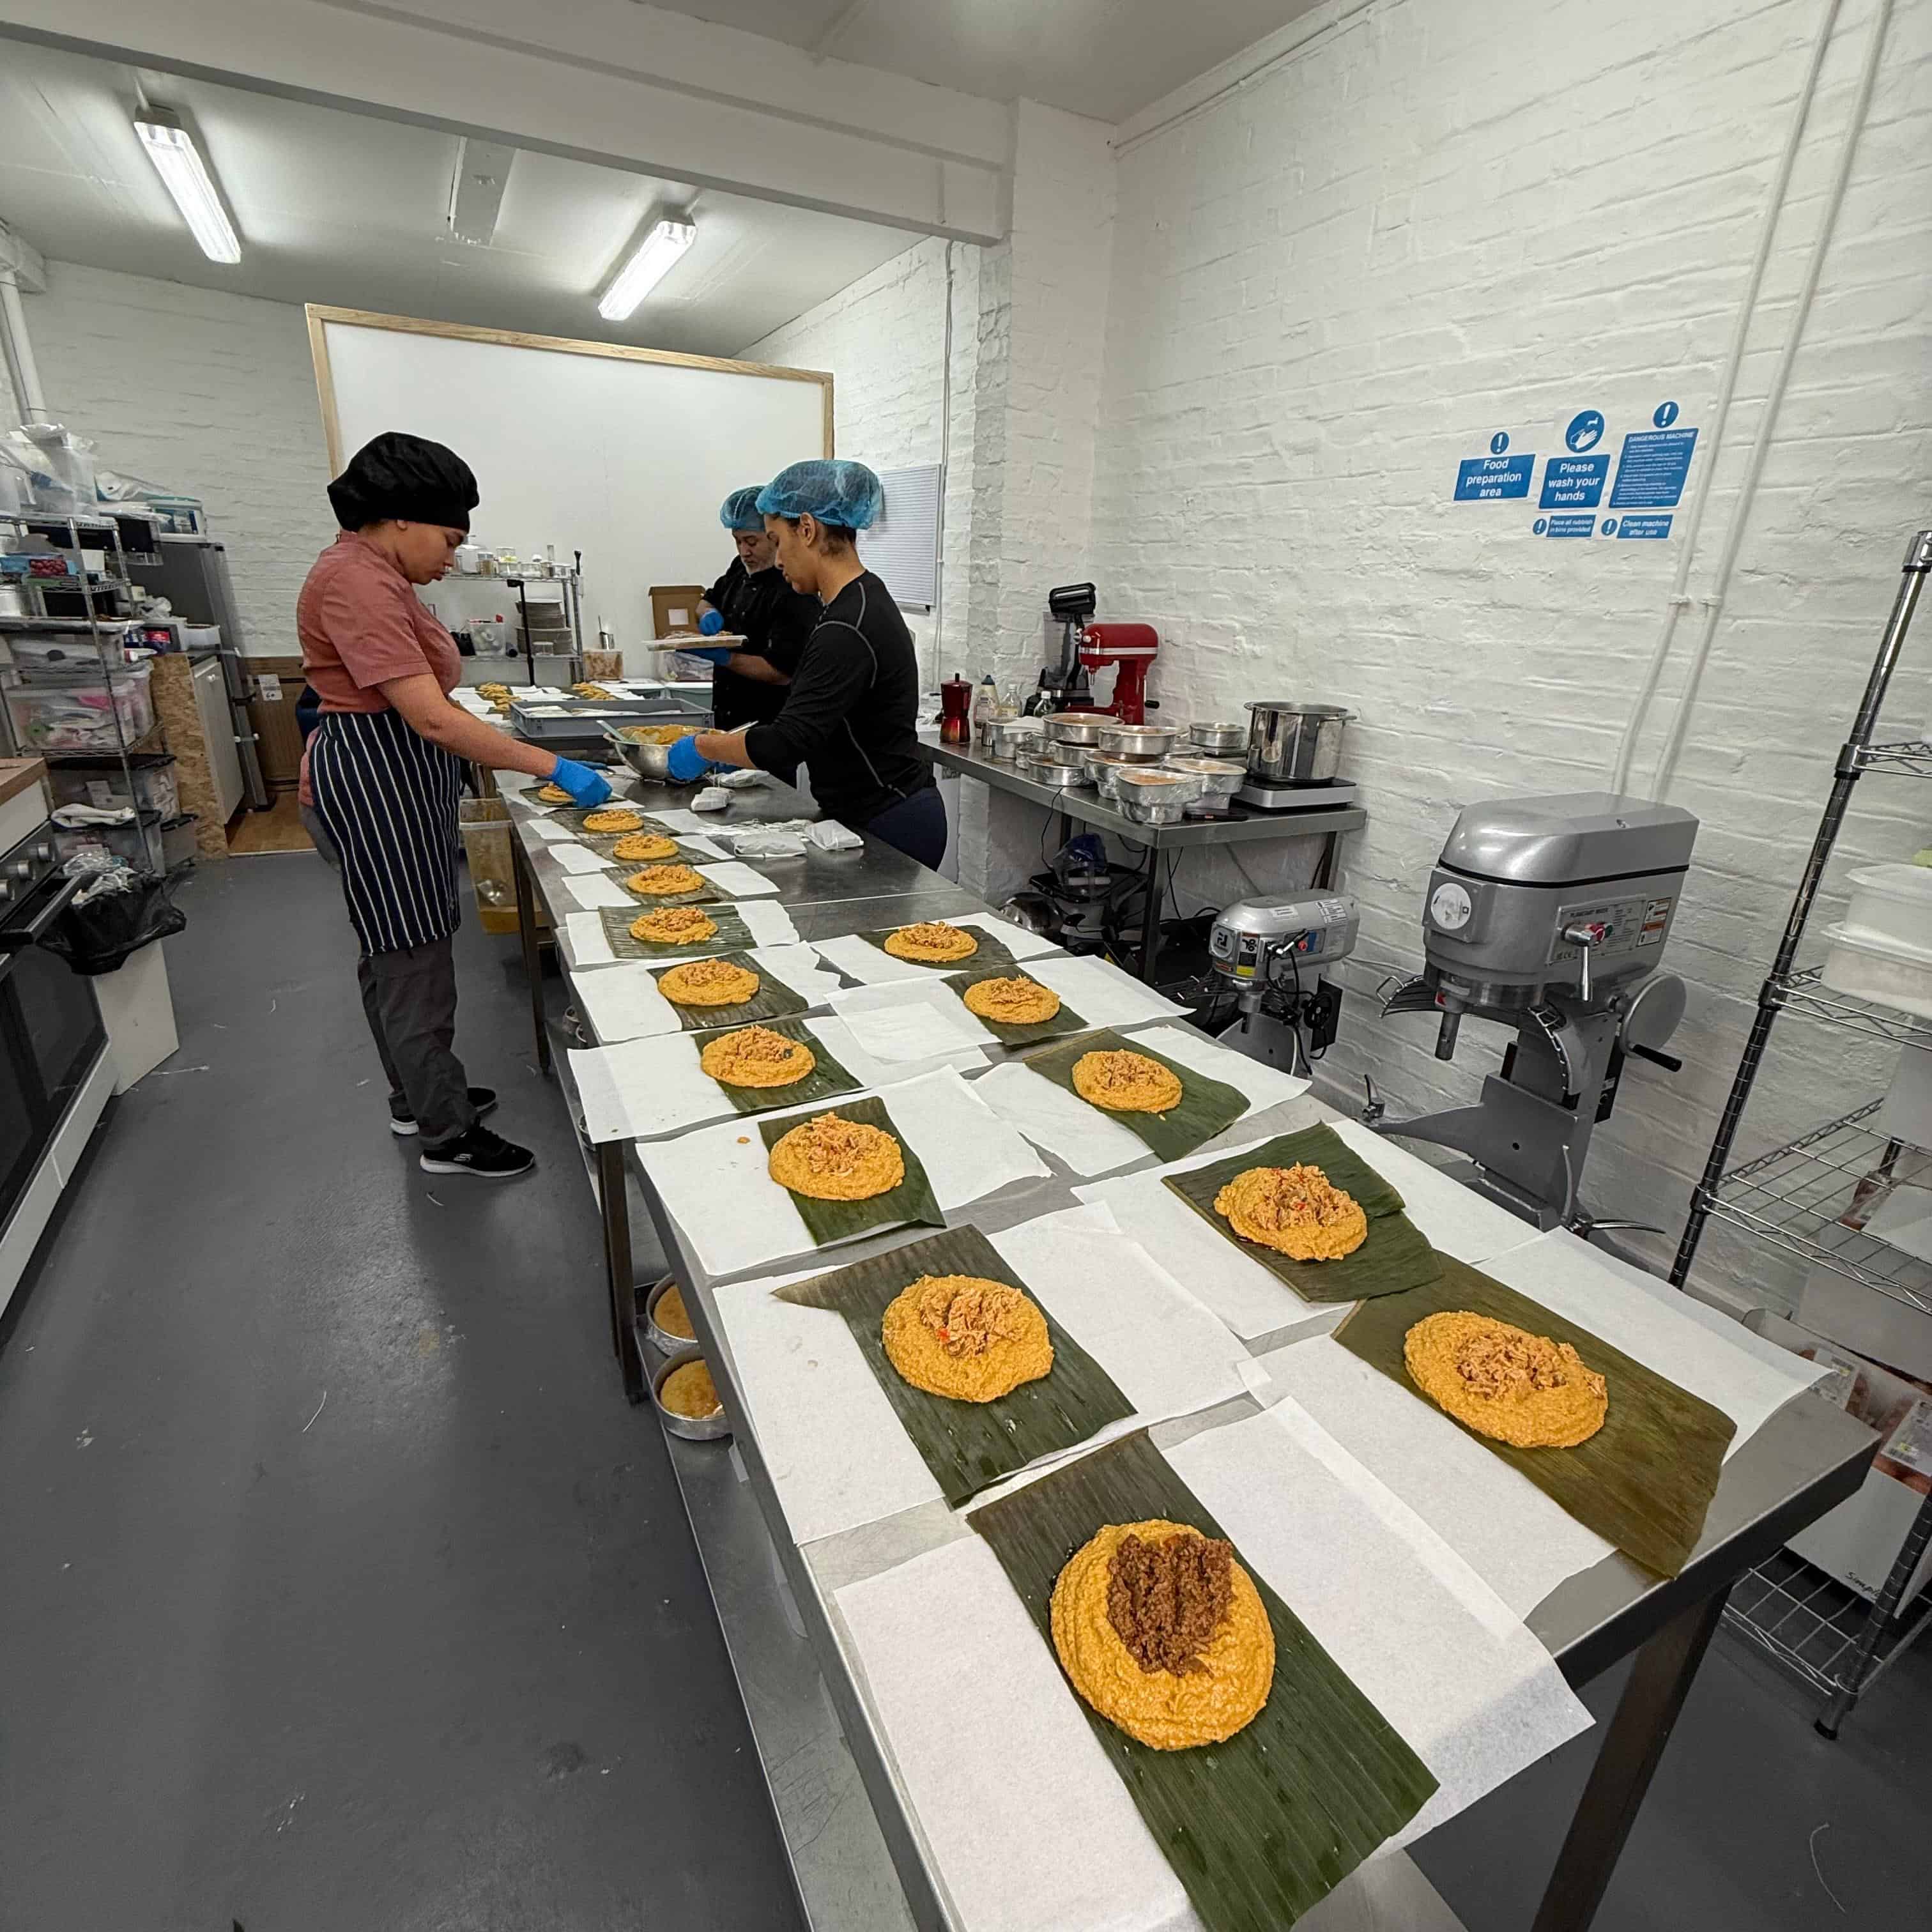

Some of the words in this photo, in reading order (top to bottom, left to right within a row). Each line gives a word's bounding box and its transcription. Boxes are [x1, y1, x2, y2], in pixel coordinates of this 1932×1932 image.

[1666, 431, 1695, 440] MACHINE
[1483, 458, 1509, 470] Food
[1560, 463, 1595, 473] Please
[1466, 471, 1522, 487] preparation
[1548, 477, 1573, 488] wash
[1575, 477, 1600, 489] your
[1480, 487, 1502, 497] area
[1554, 491, 1585, 501] hands
